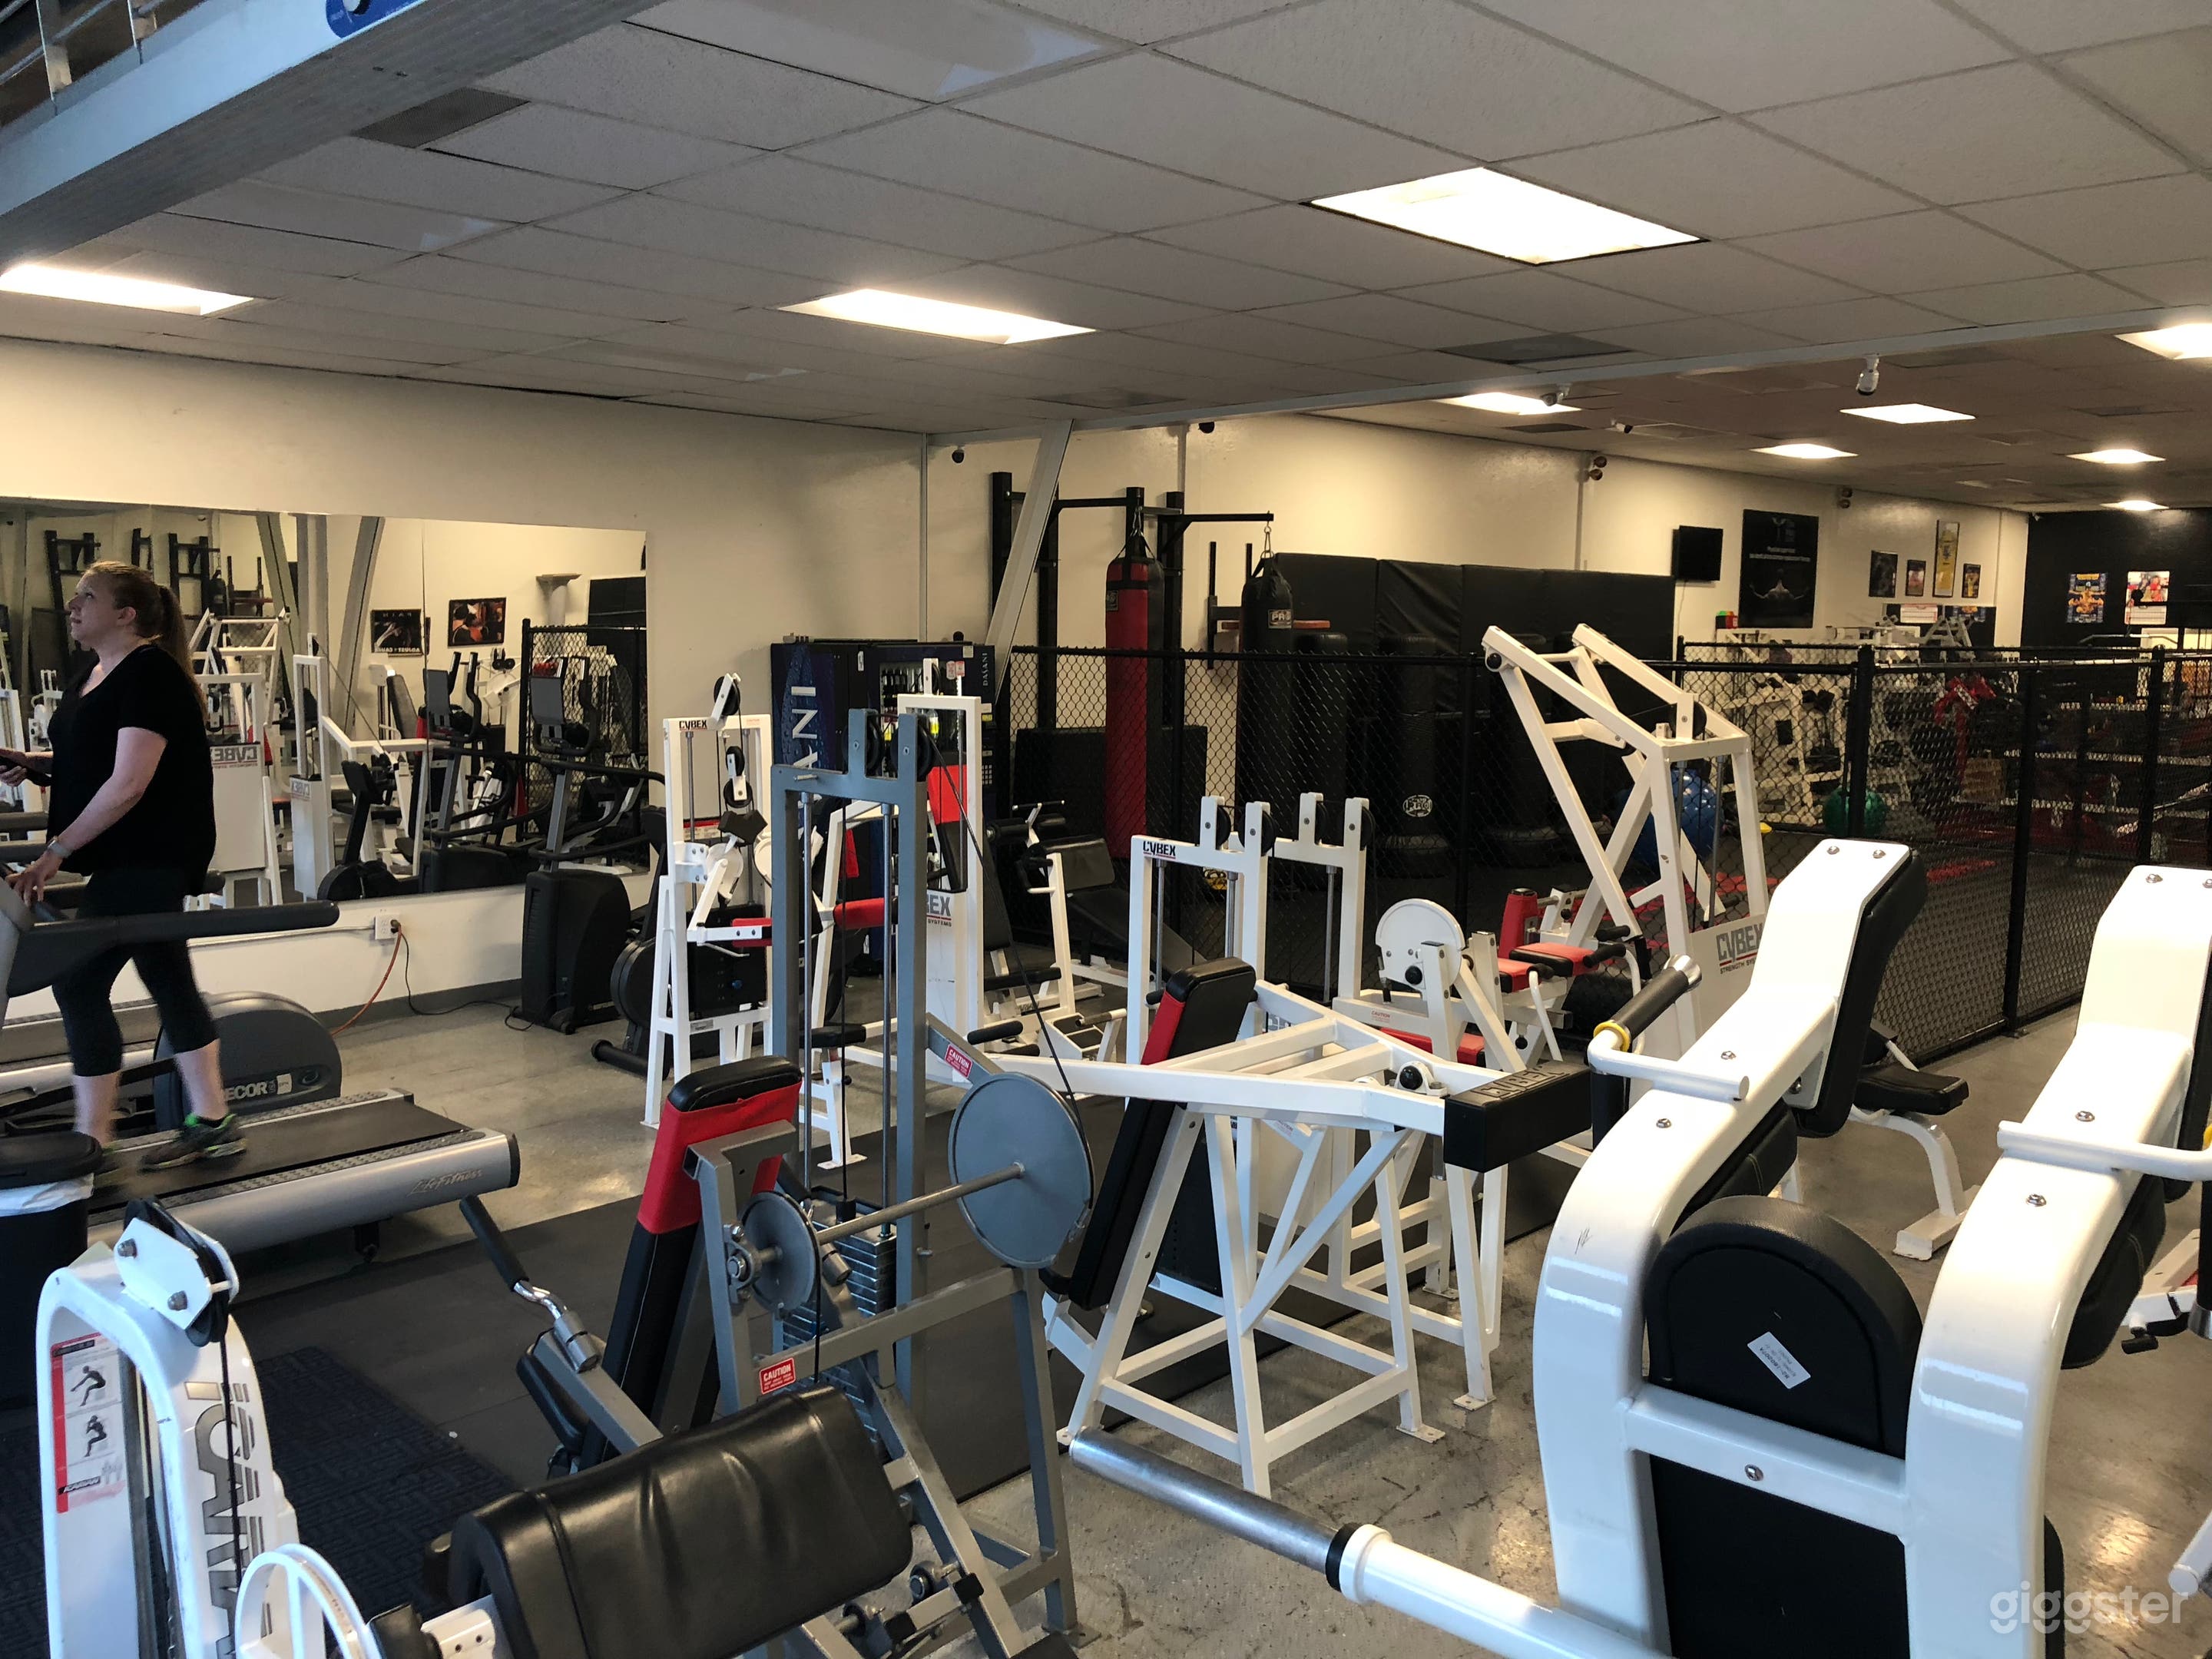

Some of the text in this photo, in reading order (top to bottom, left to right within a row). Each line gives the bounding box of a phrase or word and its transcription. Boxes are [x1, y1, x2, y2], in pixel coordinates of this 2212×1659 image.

[679, 720, 707, 730] CYBEX
[1143, 841, 1176, 856] CYBEX
[949, 1049, 969, 1068] CAUTION
[224, 1081, 268, 1100] ECOR
[763, 1363, 792, 1382] CAUTION
